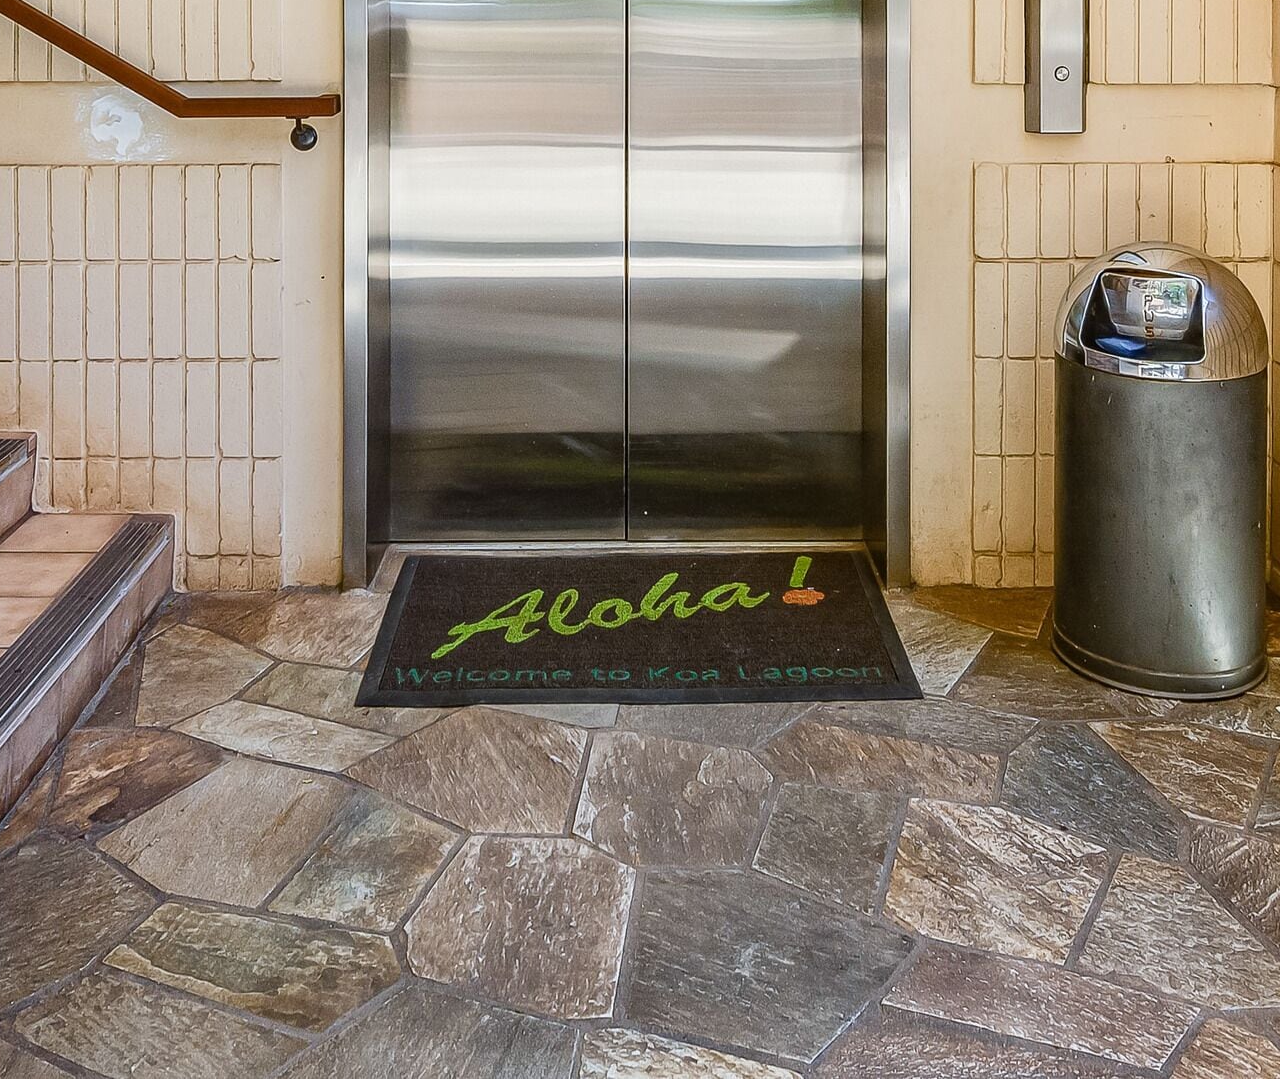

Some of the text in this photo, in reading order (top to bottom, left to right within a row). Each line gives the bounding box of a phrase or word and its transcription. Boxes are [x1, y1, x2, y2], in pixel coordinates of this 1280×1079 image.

[395, 665, 882, 685] Welcome to Koa Lagoon
